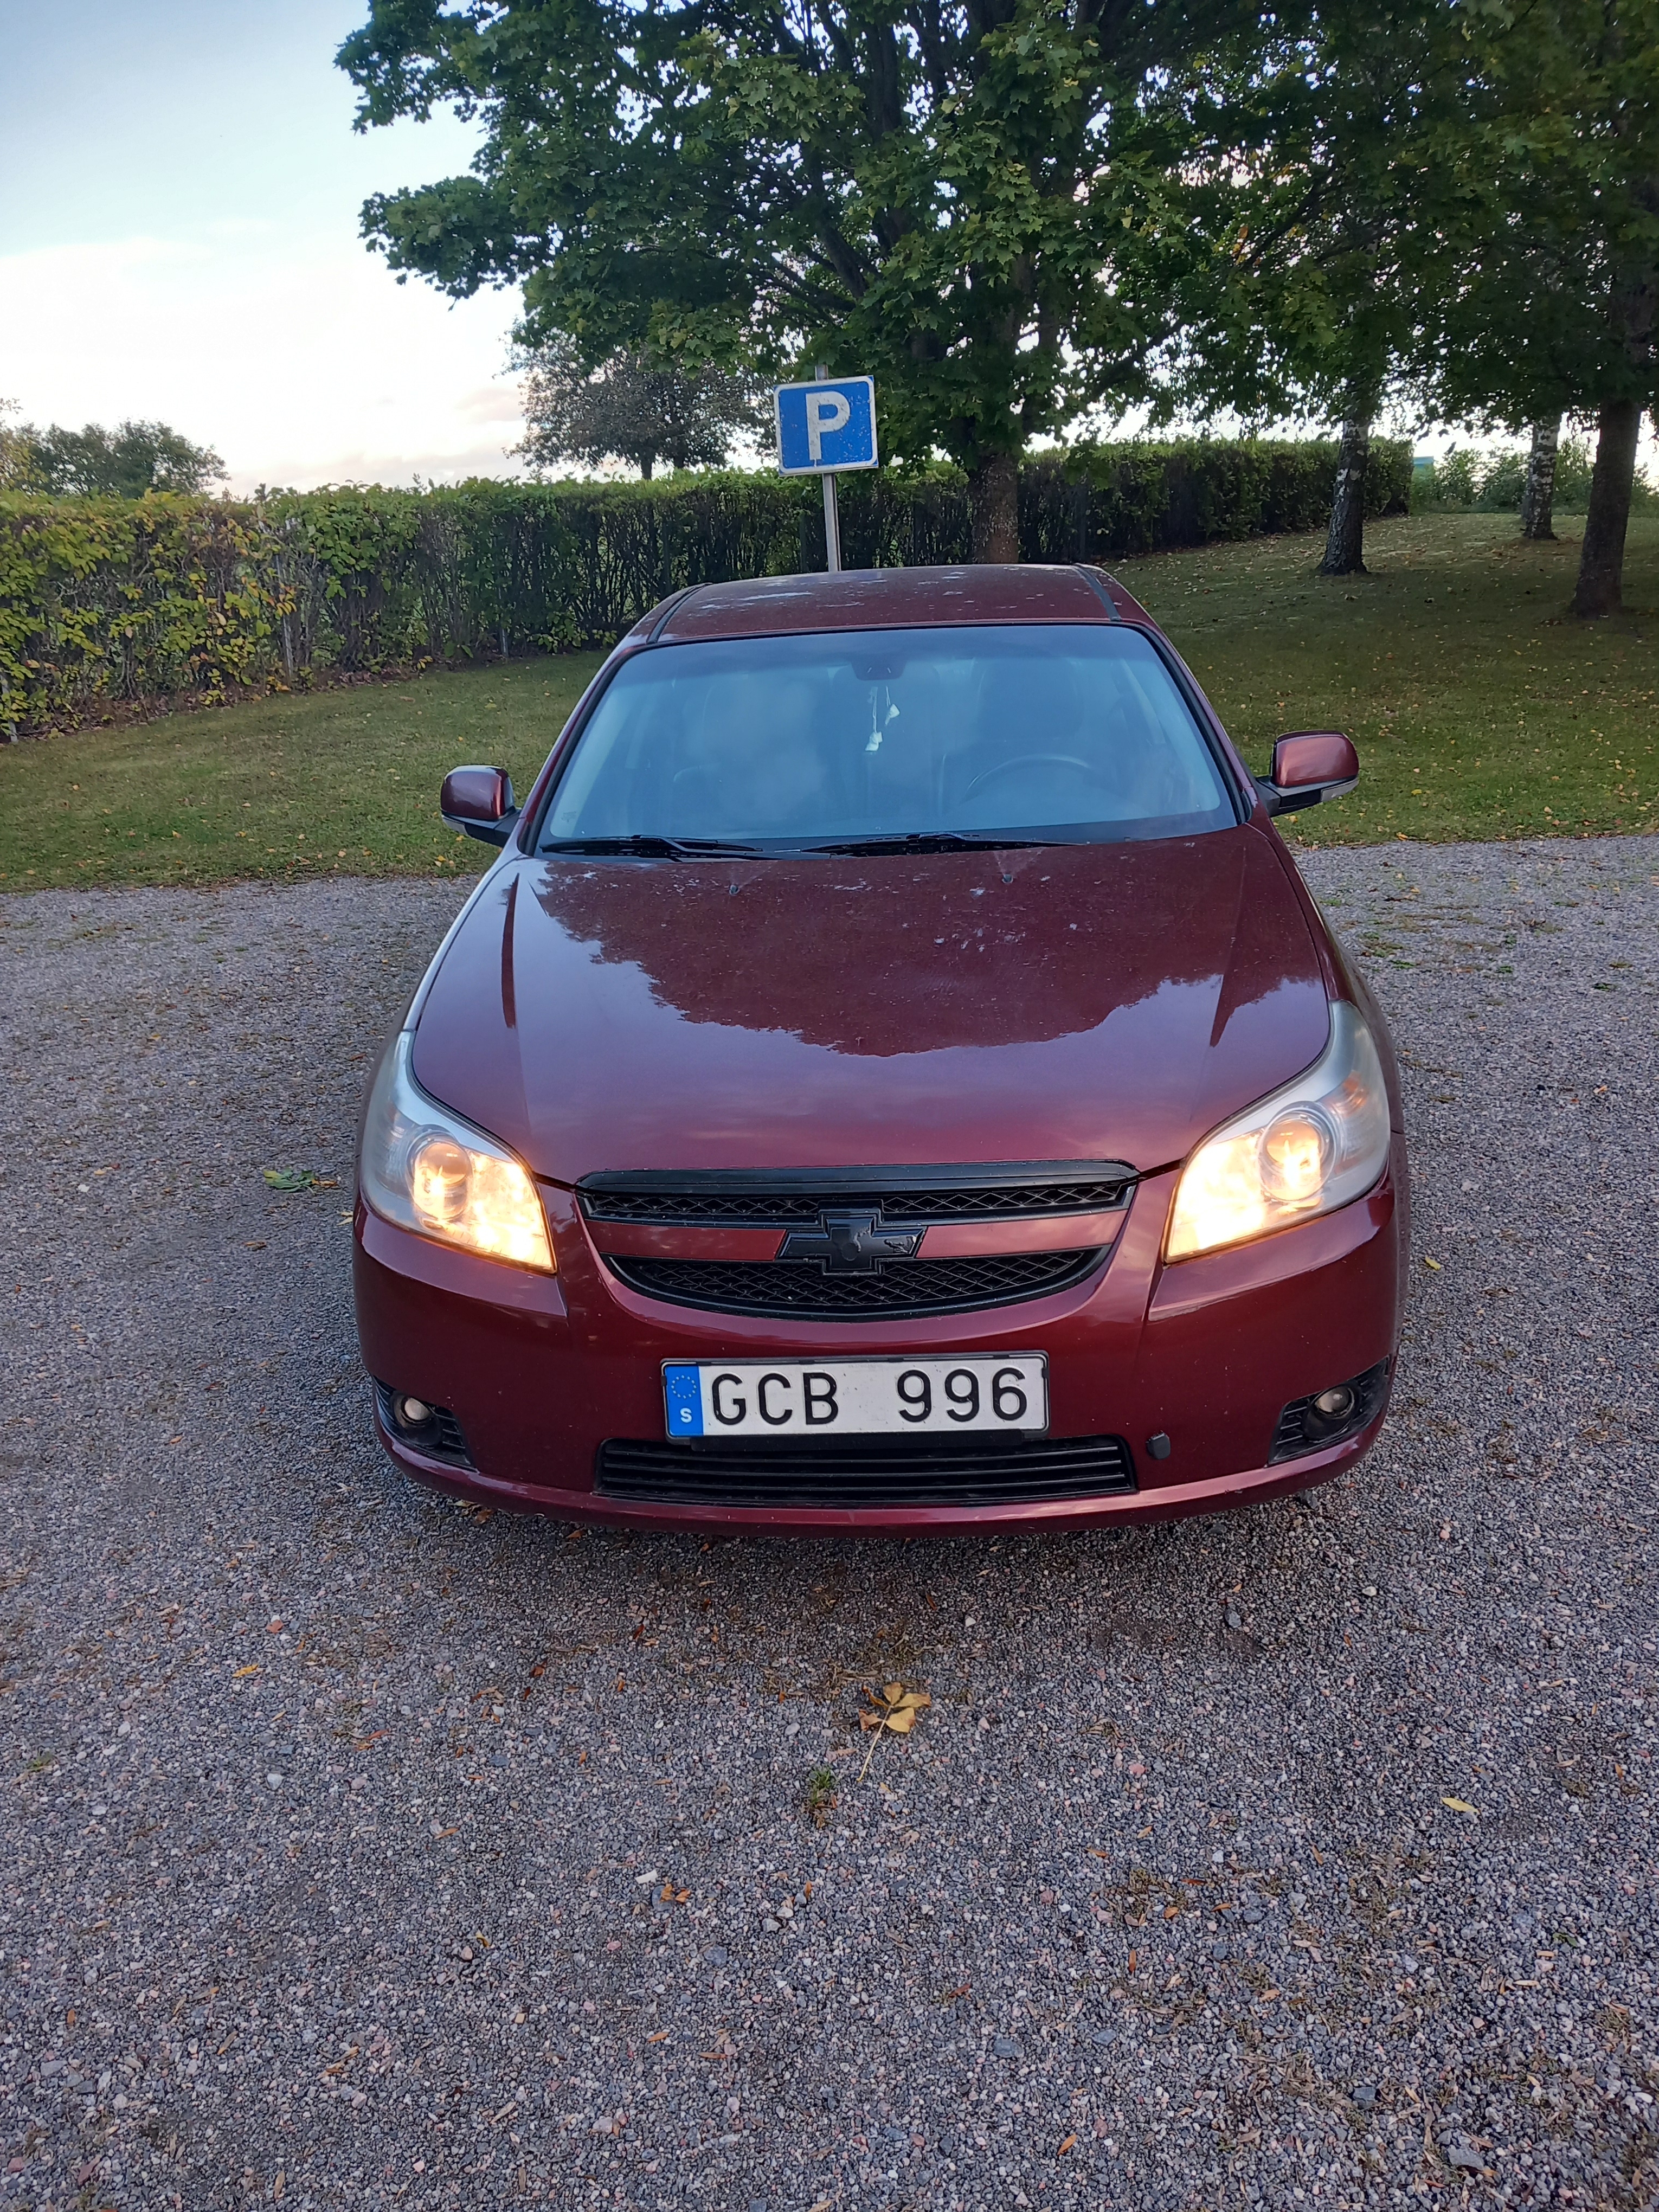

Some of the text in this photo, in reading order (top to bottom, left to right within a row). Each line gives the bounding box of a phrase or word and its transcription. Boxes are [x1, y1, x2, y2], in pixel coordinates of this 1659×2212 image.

[806, 391, 851, 460] P
[680, 1407, 692, 1423] S
[711, 1367, 1027, 1426] GCB 996
